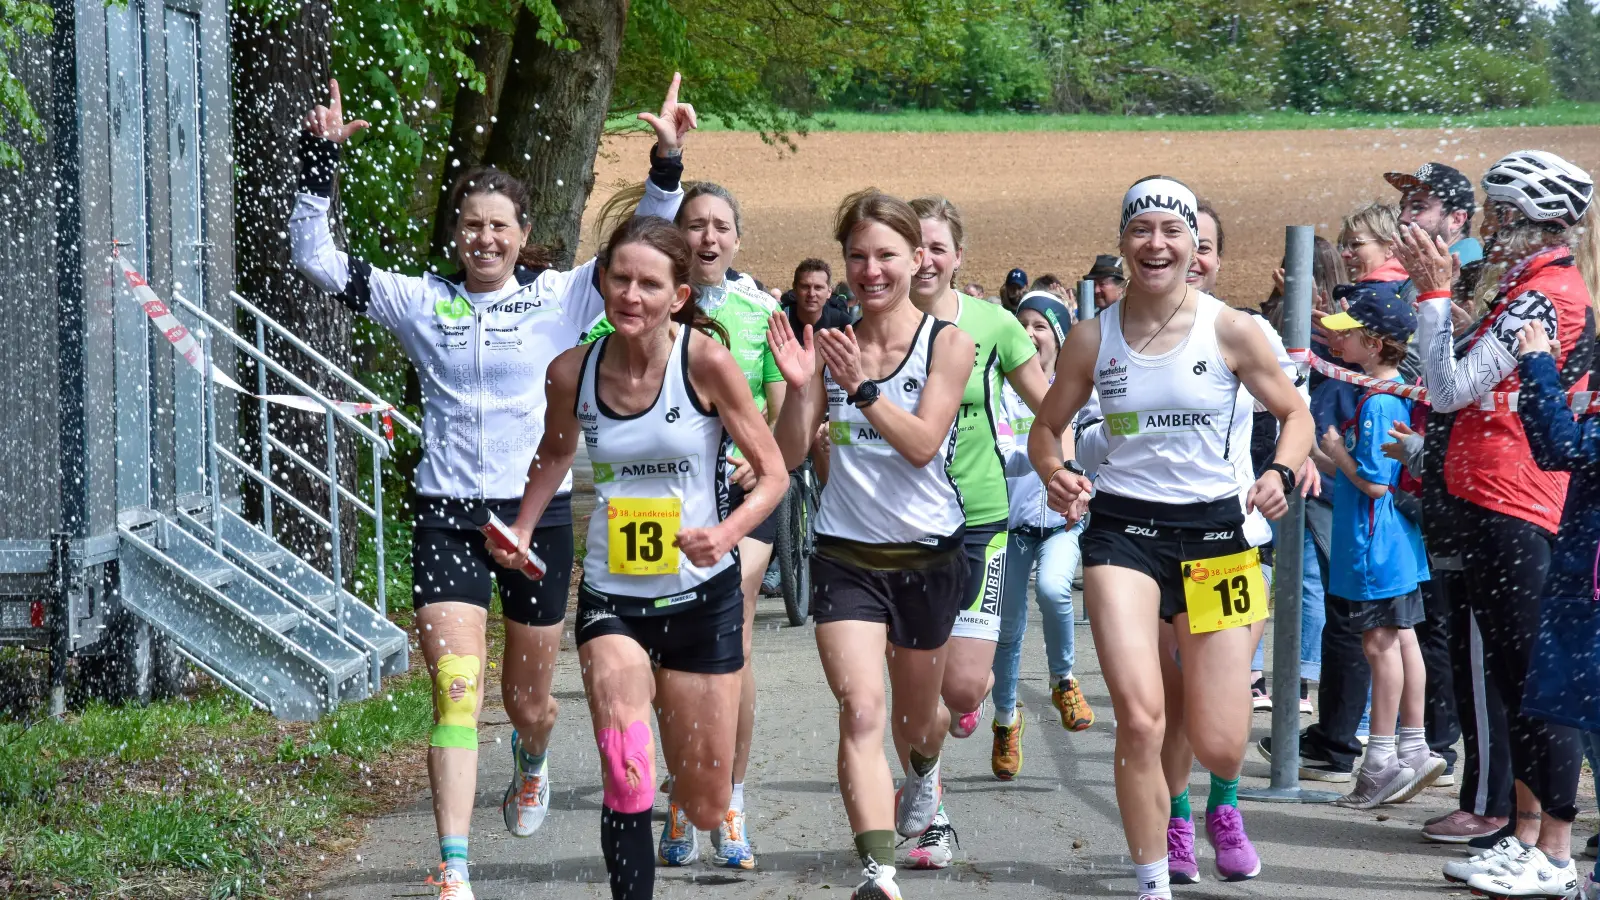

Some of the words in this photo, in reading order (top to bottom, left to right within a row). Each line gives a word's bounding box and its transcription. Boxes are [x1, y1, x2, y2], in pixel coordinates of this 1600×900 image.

[1112, 417, 1132, 431] CIS
[1146, 413, 1212, 428] AMBERG
[831, 427, 844, 440] IS
[857, 427, 882, 440] AM
[621, 460, 690, 476] AMBERG
[1124, 525, 1158, 537] 2XU
[1203, 531, 1235, 540] 2XU
[620, 521, 663, 562] 13
[1211, 569, 1223, 577] 38.
[1213, 575, 1251, 617] 13
[958, 616, 989, 625] AMBERG
